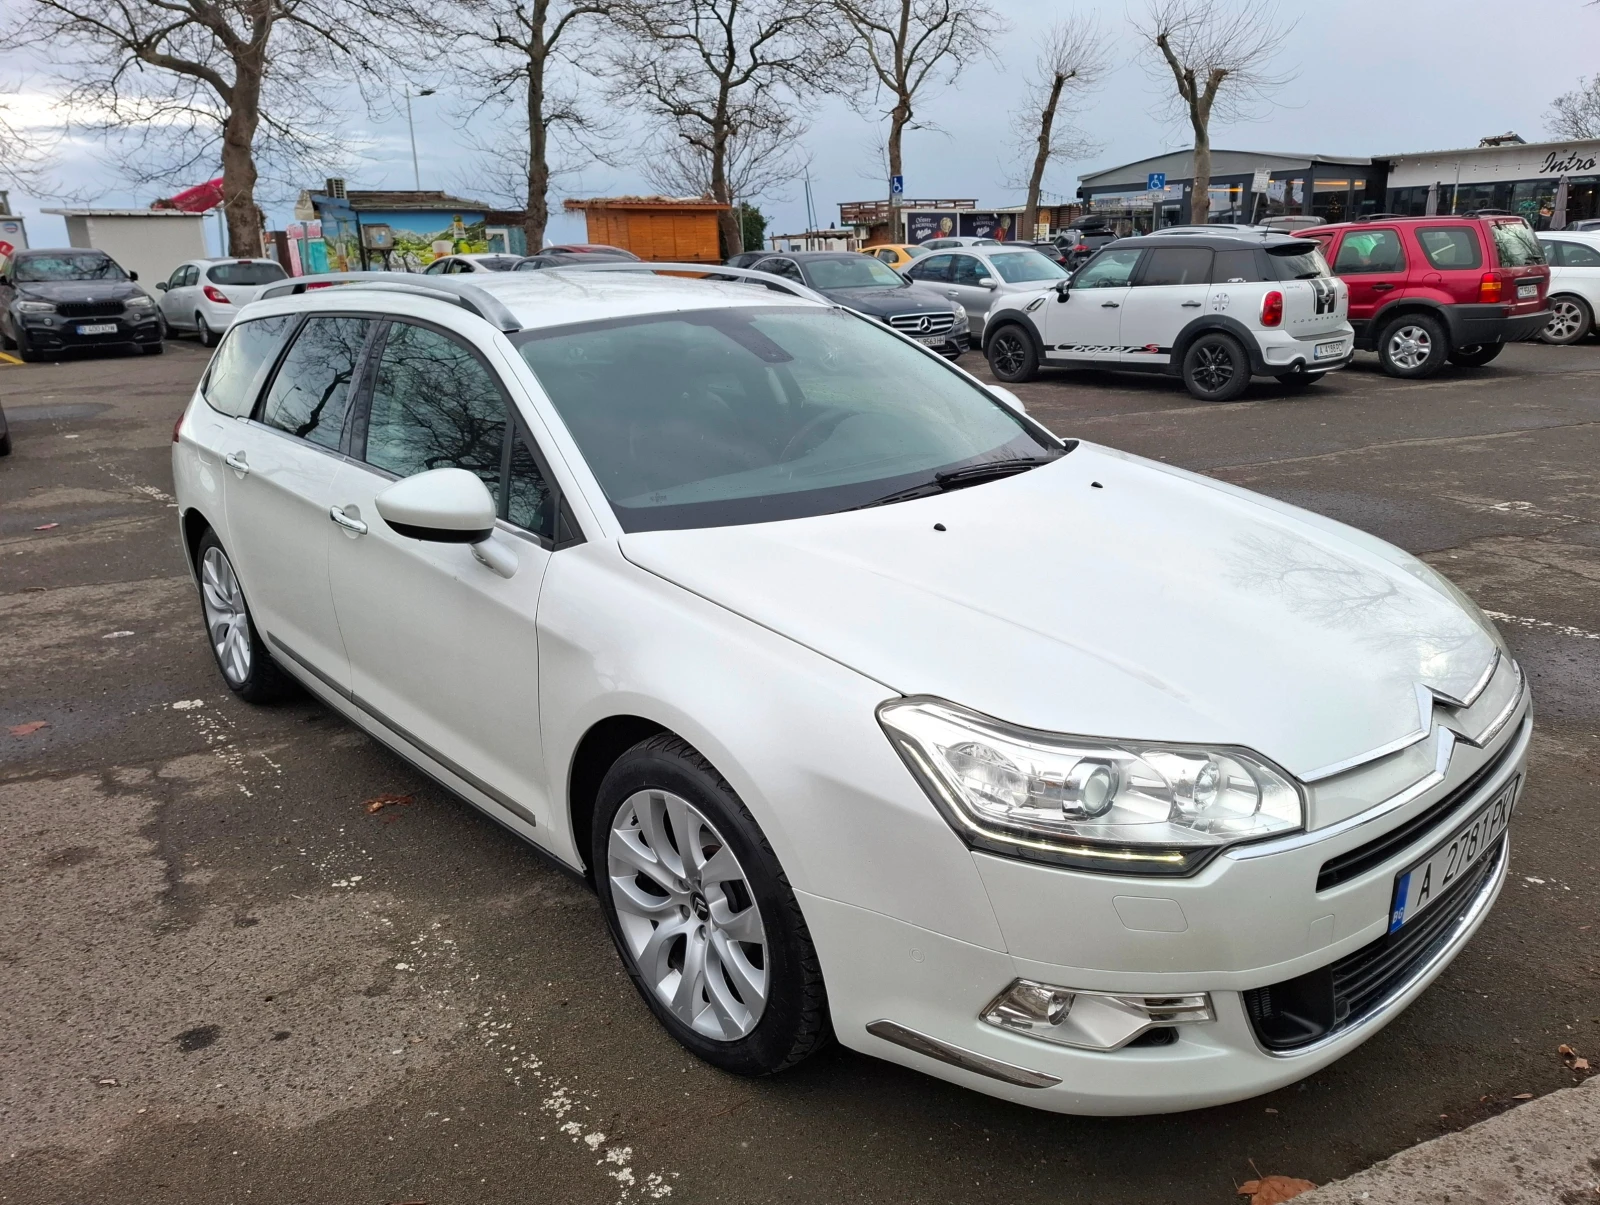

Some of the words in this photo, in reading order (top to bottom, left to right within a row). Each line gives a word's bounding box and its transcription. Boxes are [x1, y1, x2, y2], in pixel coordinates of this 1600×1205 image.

[1539, 151, 1596, 173] Intro
[916, 228, 931, 239] Milka
[976, 225, 990, 237] Milka
[1054, 342, 1143, 358] Cooper
[1145, 343, 1160, 354] S
[1417, 862, 1432, 907] A
[1392, 906, 1404, 924] BG
